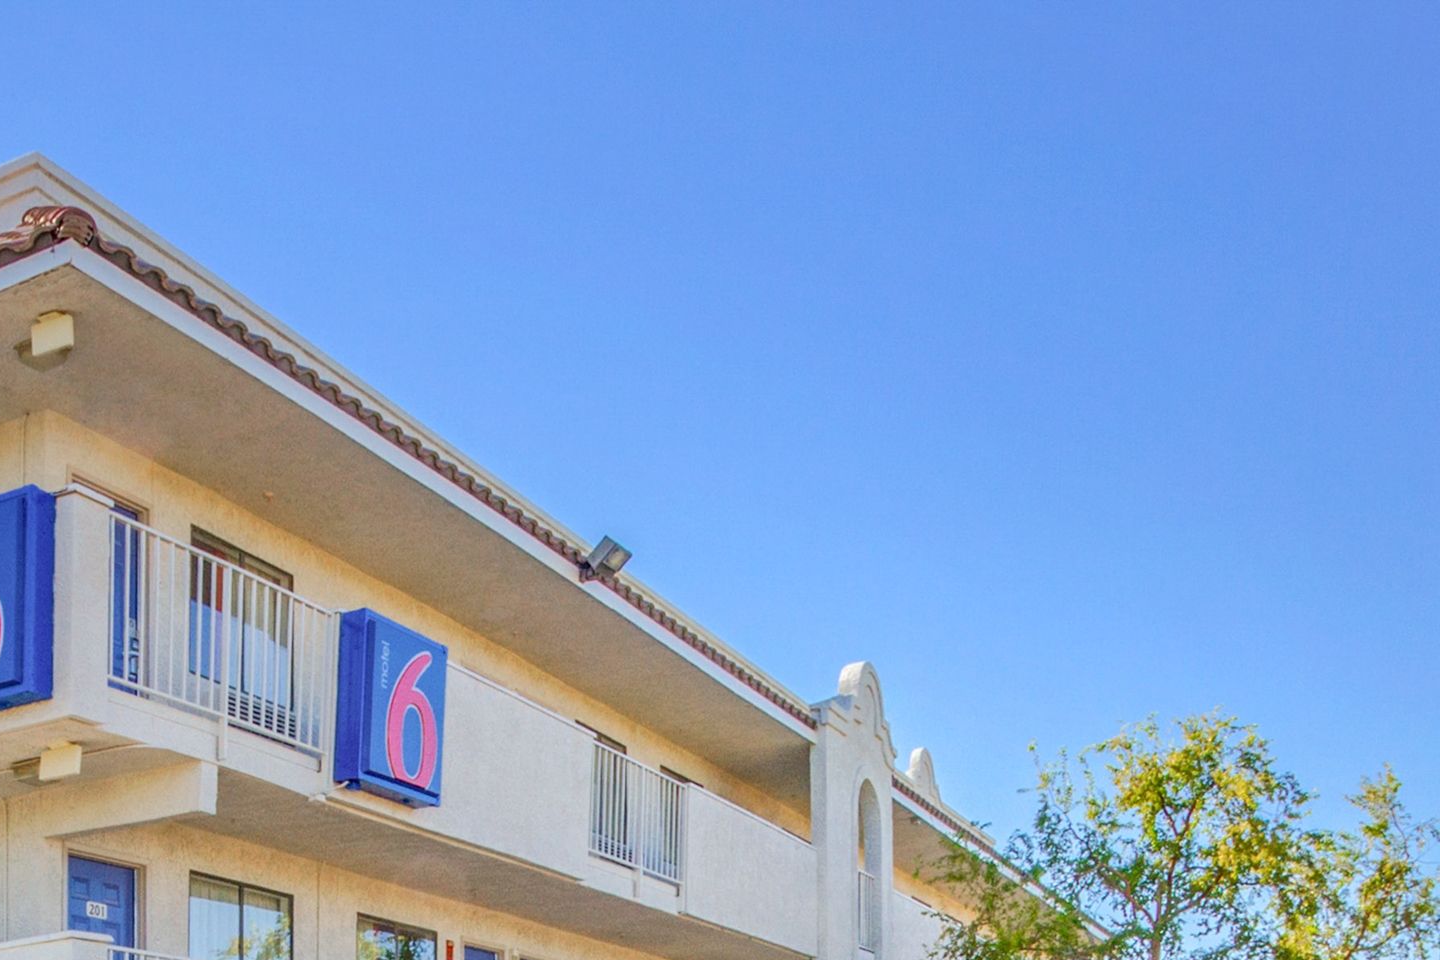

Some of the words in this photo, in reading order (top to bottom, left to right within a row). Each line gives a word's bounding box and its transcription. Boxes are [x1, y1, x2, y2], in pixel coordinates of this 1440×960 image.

[380, 639, 392, 690] motel
[385, 651, 438, 790] 6
[88, 903, 106, 918] 201
